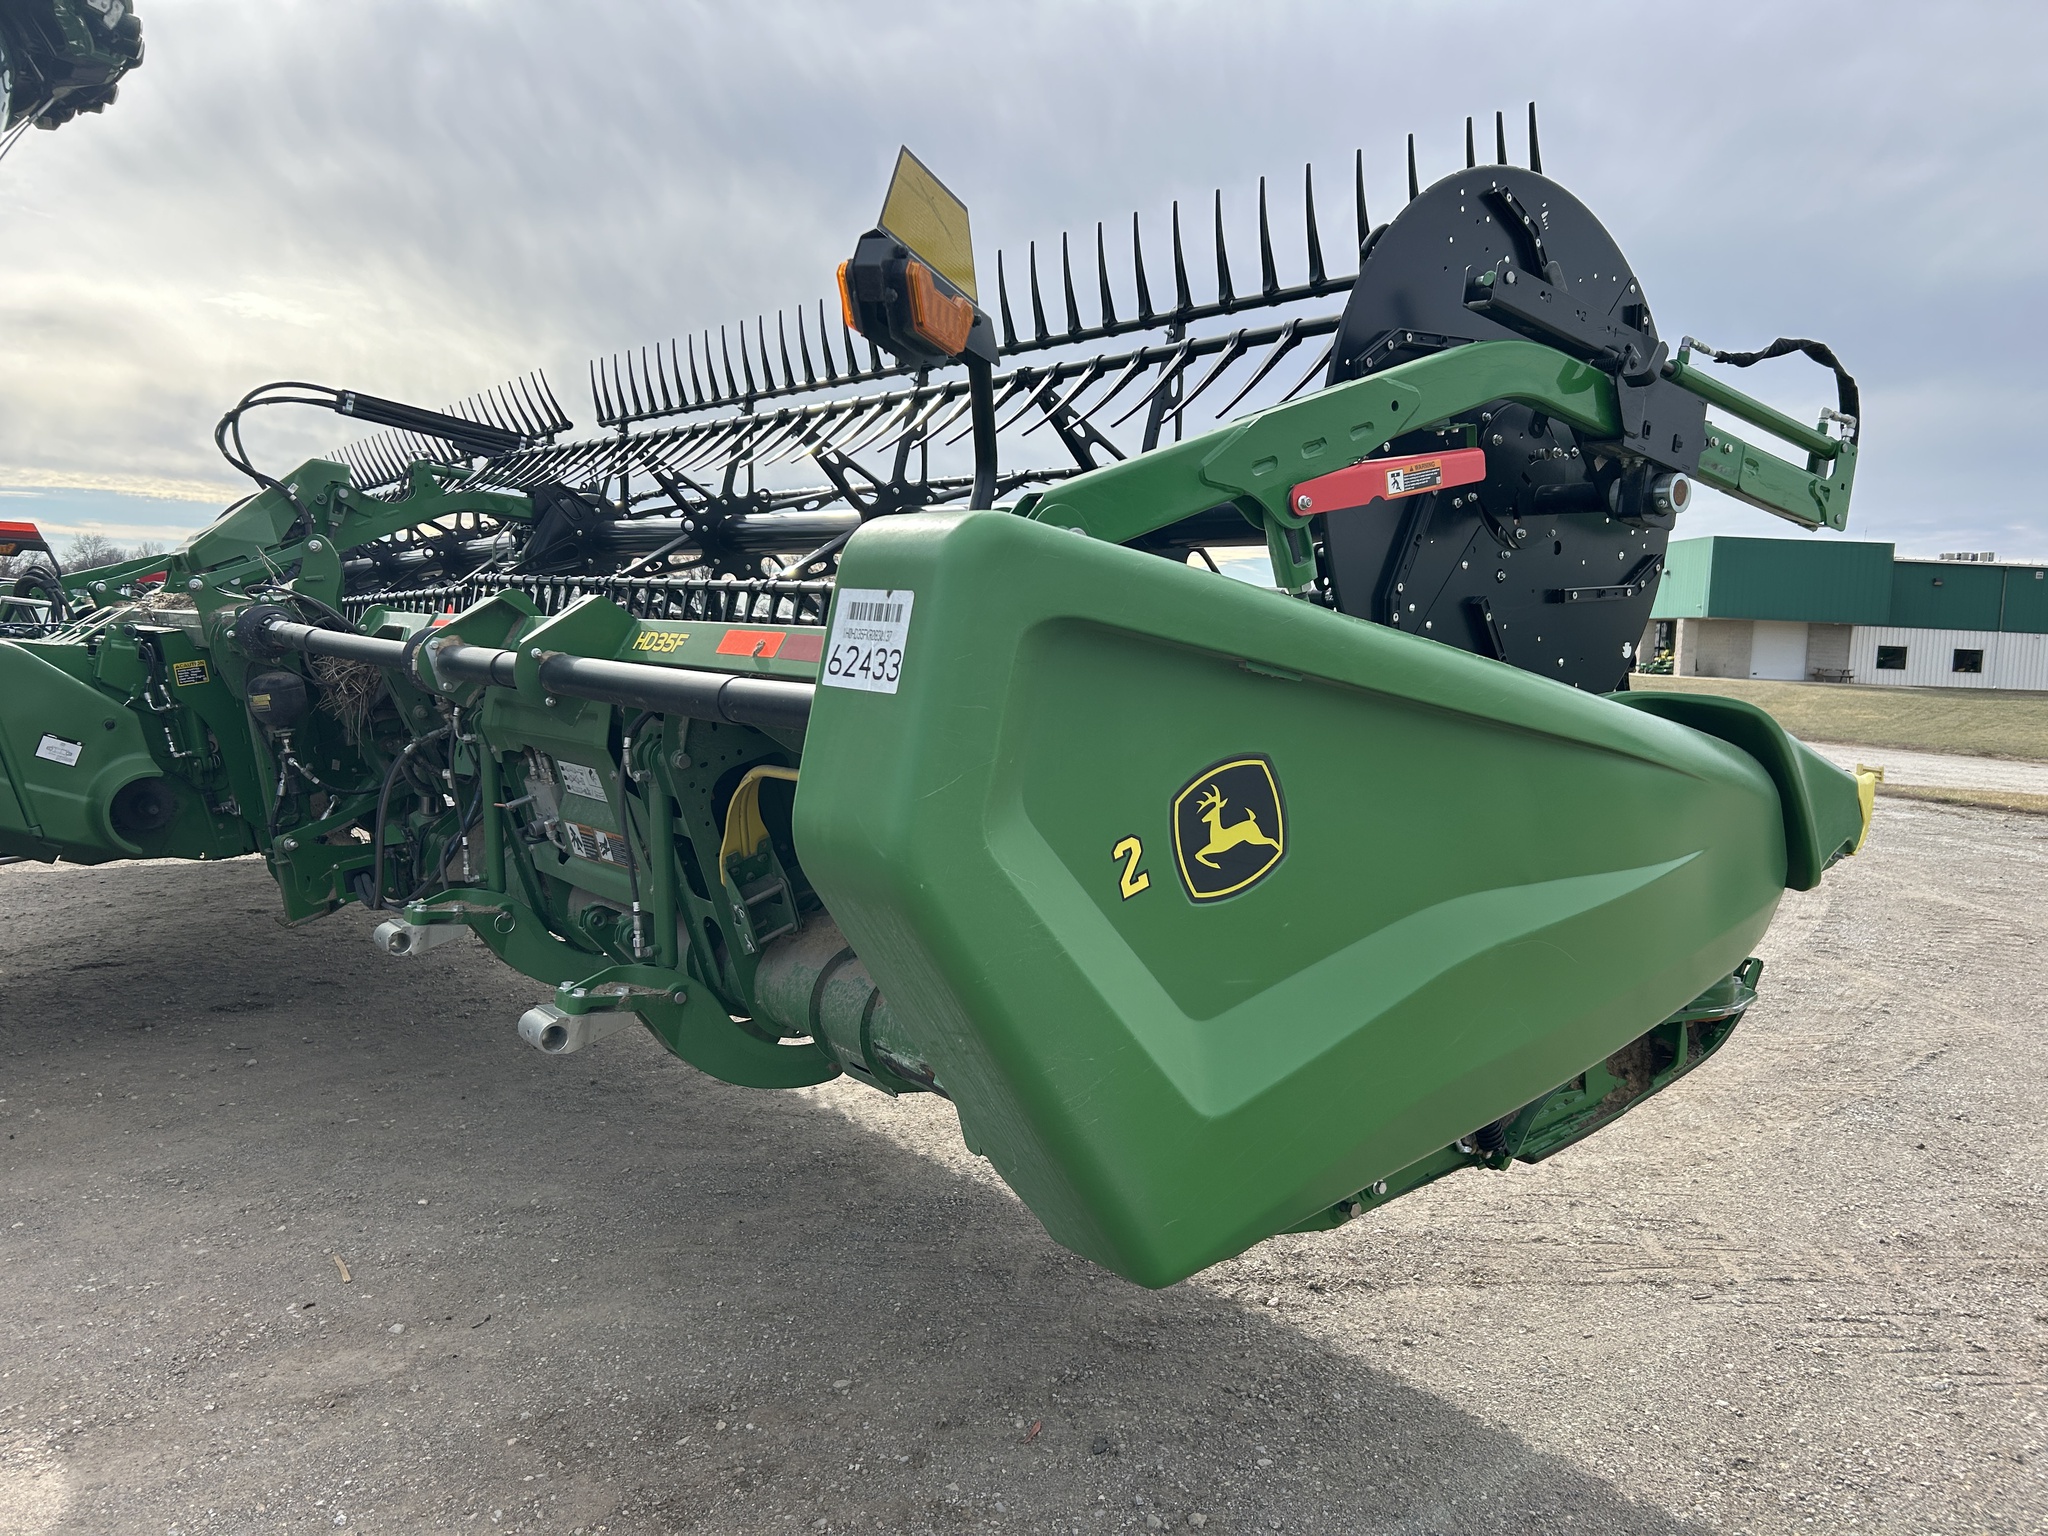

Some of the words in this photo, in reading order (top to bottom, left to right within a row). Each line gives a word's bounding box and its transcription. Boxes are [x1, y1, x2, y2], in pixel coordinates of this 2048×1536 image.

[1580, 311, 1587, 322] 2
[1415, 461, 1436, 470] WARNING
[632, 631, 690, 653] HD35F
[828, 644, 902, 682] 62433
[1111, 834, 1151, 902] 2
